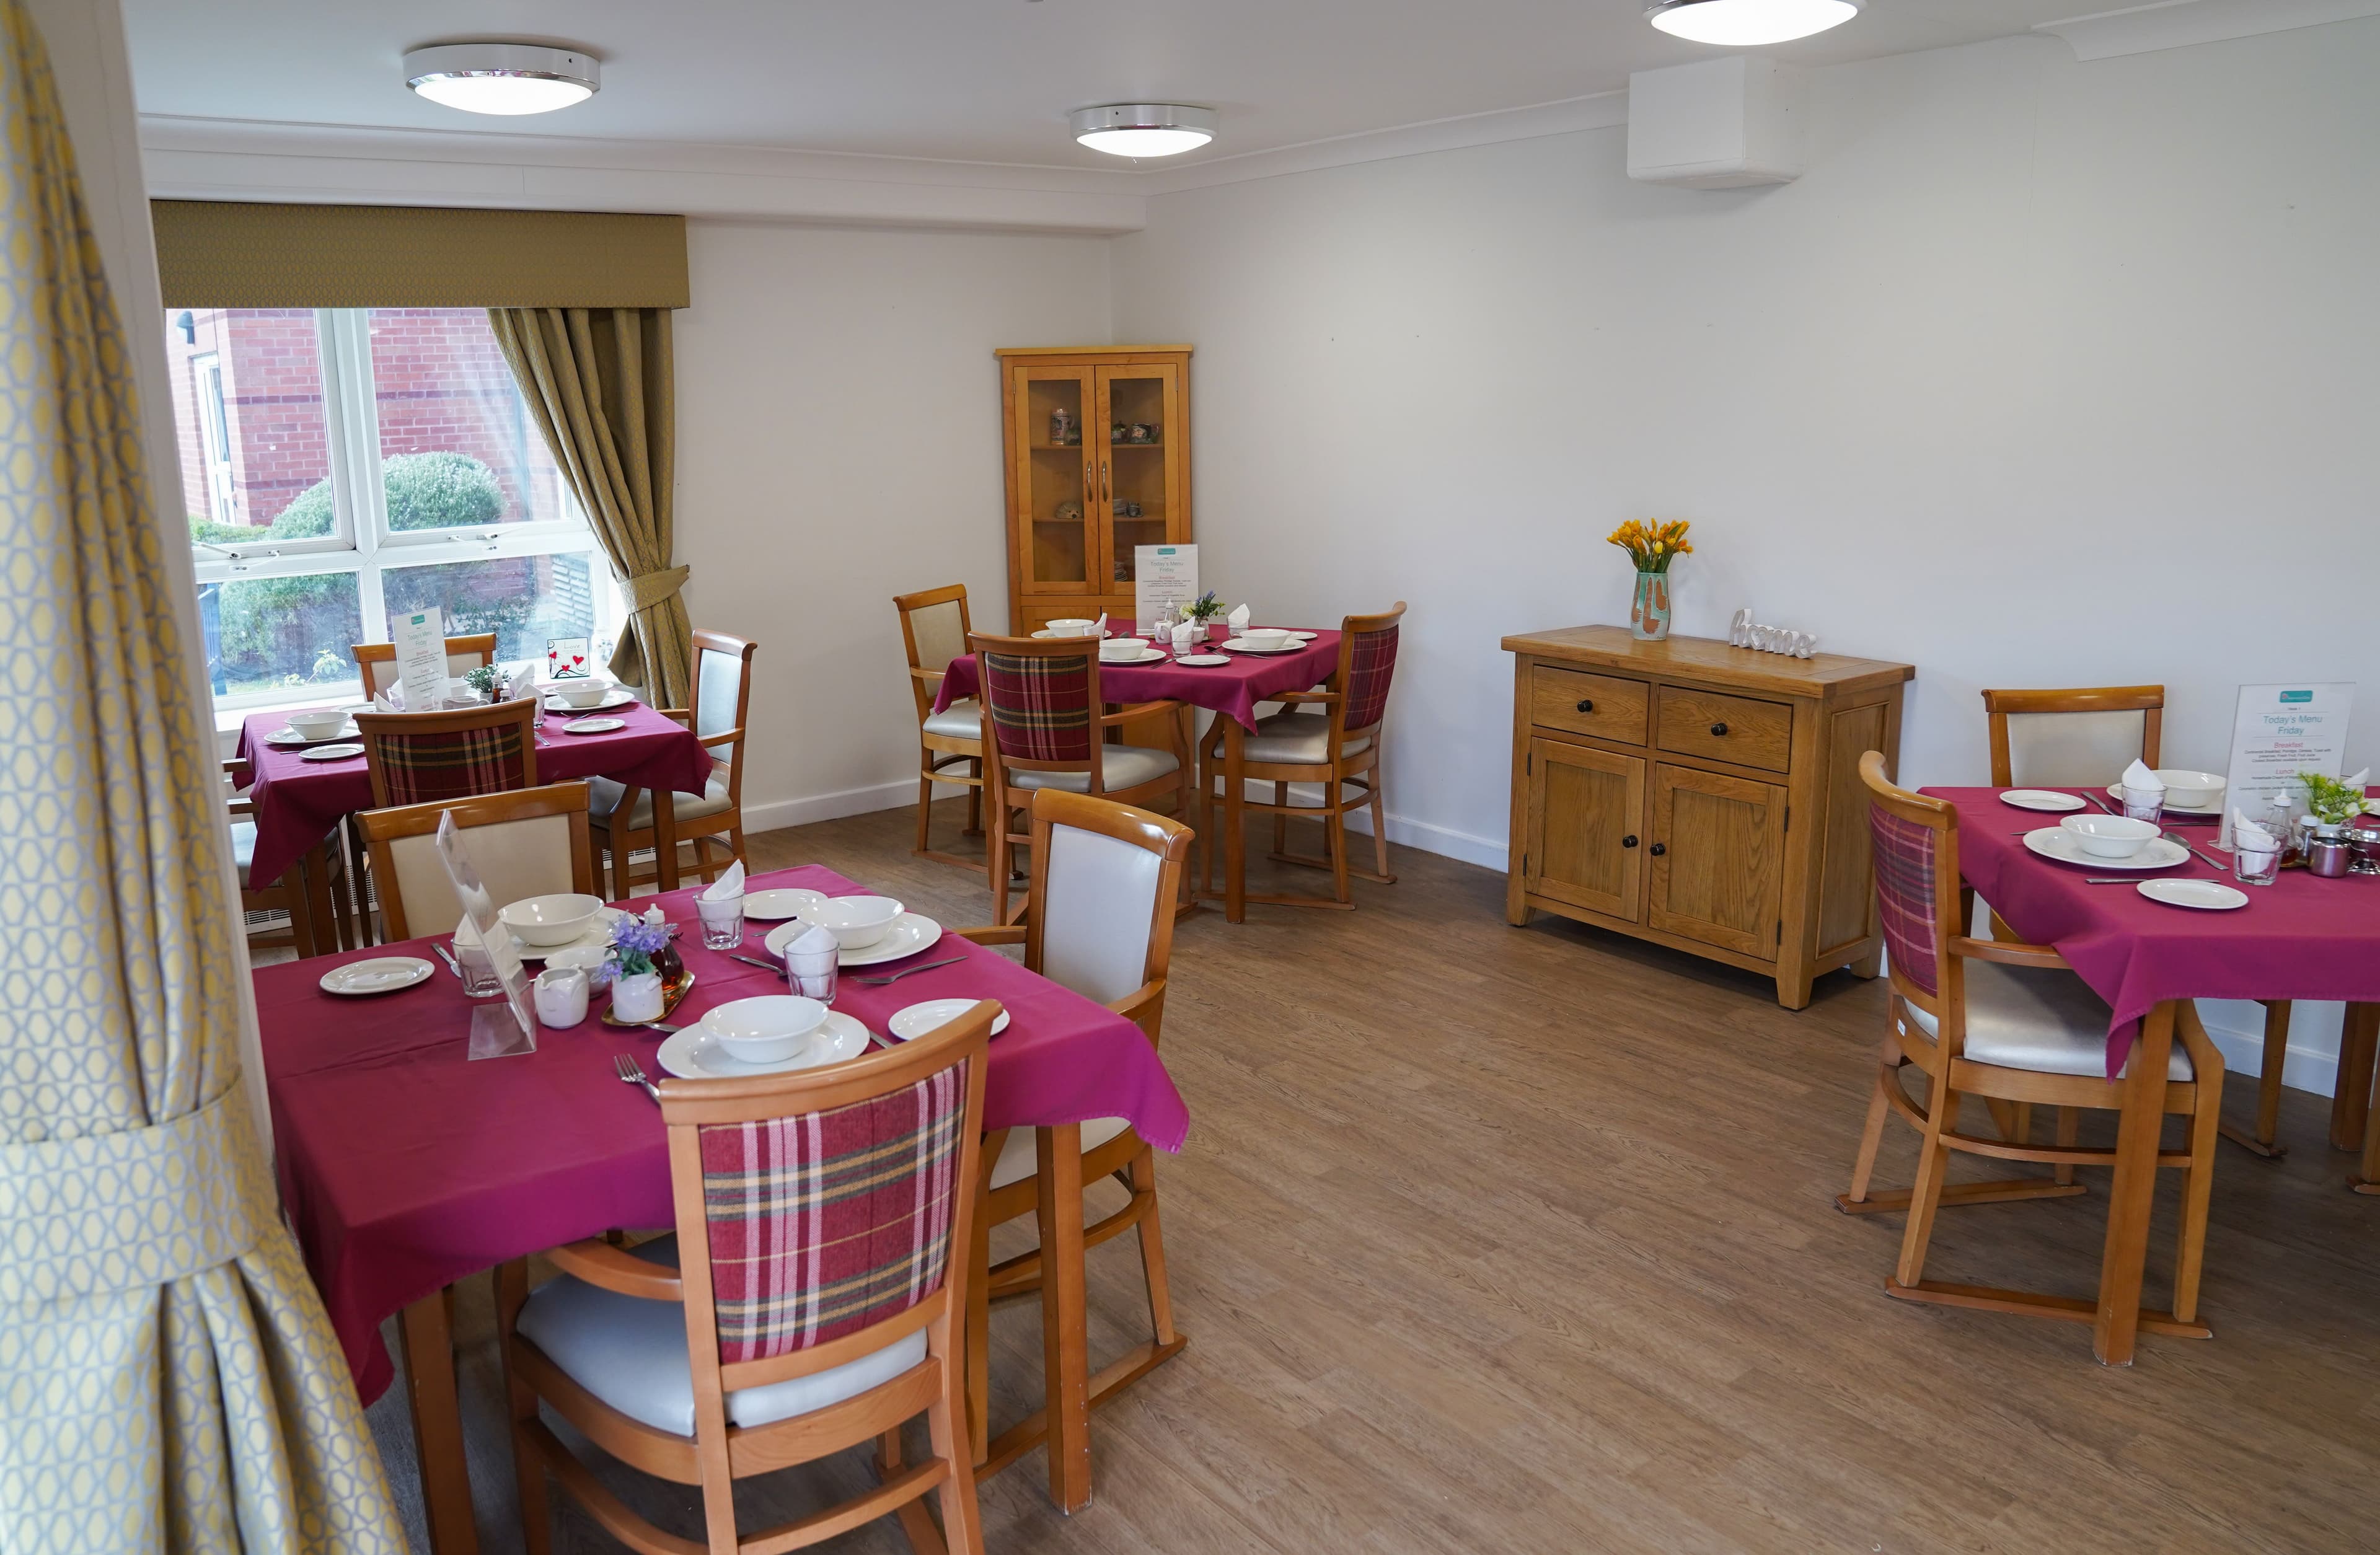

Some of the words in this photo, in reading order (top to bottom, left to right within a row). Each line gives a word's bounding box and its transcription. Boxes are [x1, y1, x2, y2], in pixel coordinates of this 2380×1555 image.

[1729, 608, 1818, 659] home
[565, 640, 580, 649] Love
[2263, 715, 2296, 725] Today's
[2278, 726, 2304, 735] Friday
